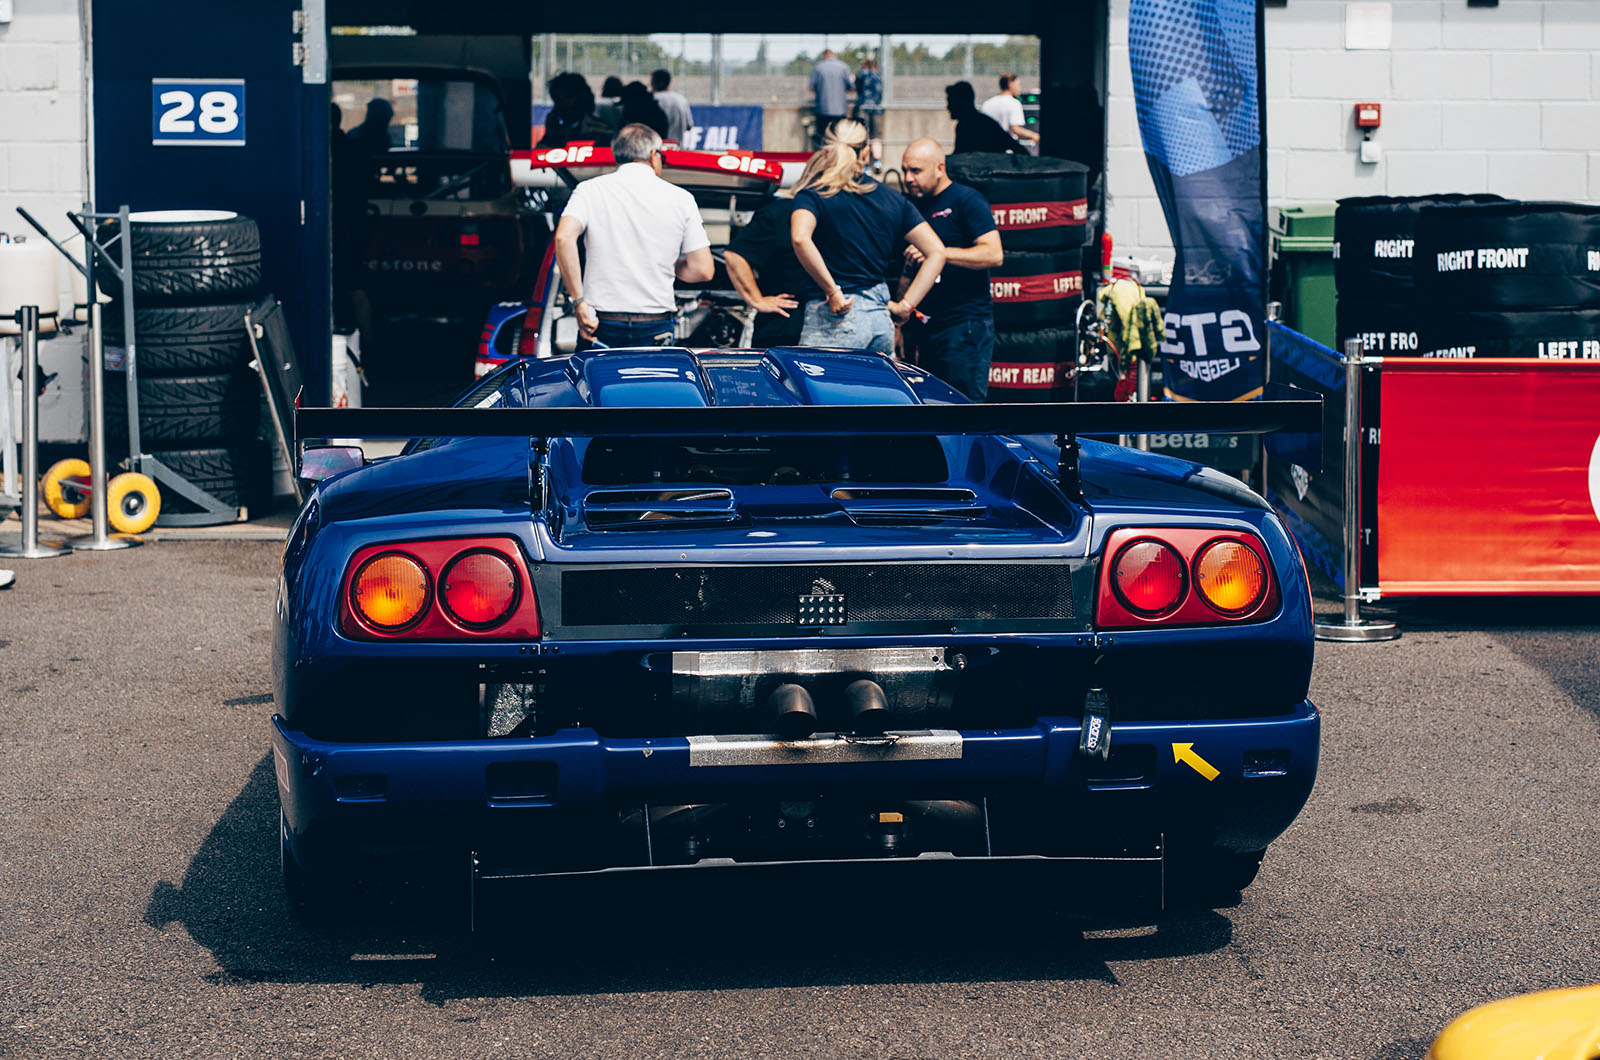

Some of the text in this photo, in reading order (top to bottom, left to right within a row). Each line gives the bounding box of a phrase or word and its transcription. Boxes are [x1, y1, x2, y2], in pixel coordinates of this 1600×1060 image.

[159, 90, 239, 134] 28
[703, 126, 740, 150] ALL
[1008, 207, 1048, 225] FRONT
[1374, 239, 1415, 258] RIGHT
[1436, 247, 1529, 272] RIGHT FRONT
[1390, 332, 1418, 350] FRO
[1538, 341, 1578, 359] LEFT
[1023, 368, 1055, 384] REAR
[1150, 434, 1209, 448] Beta
